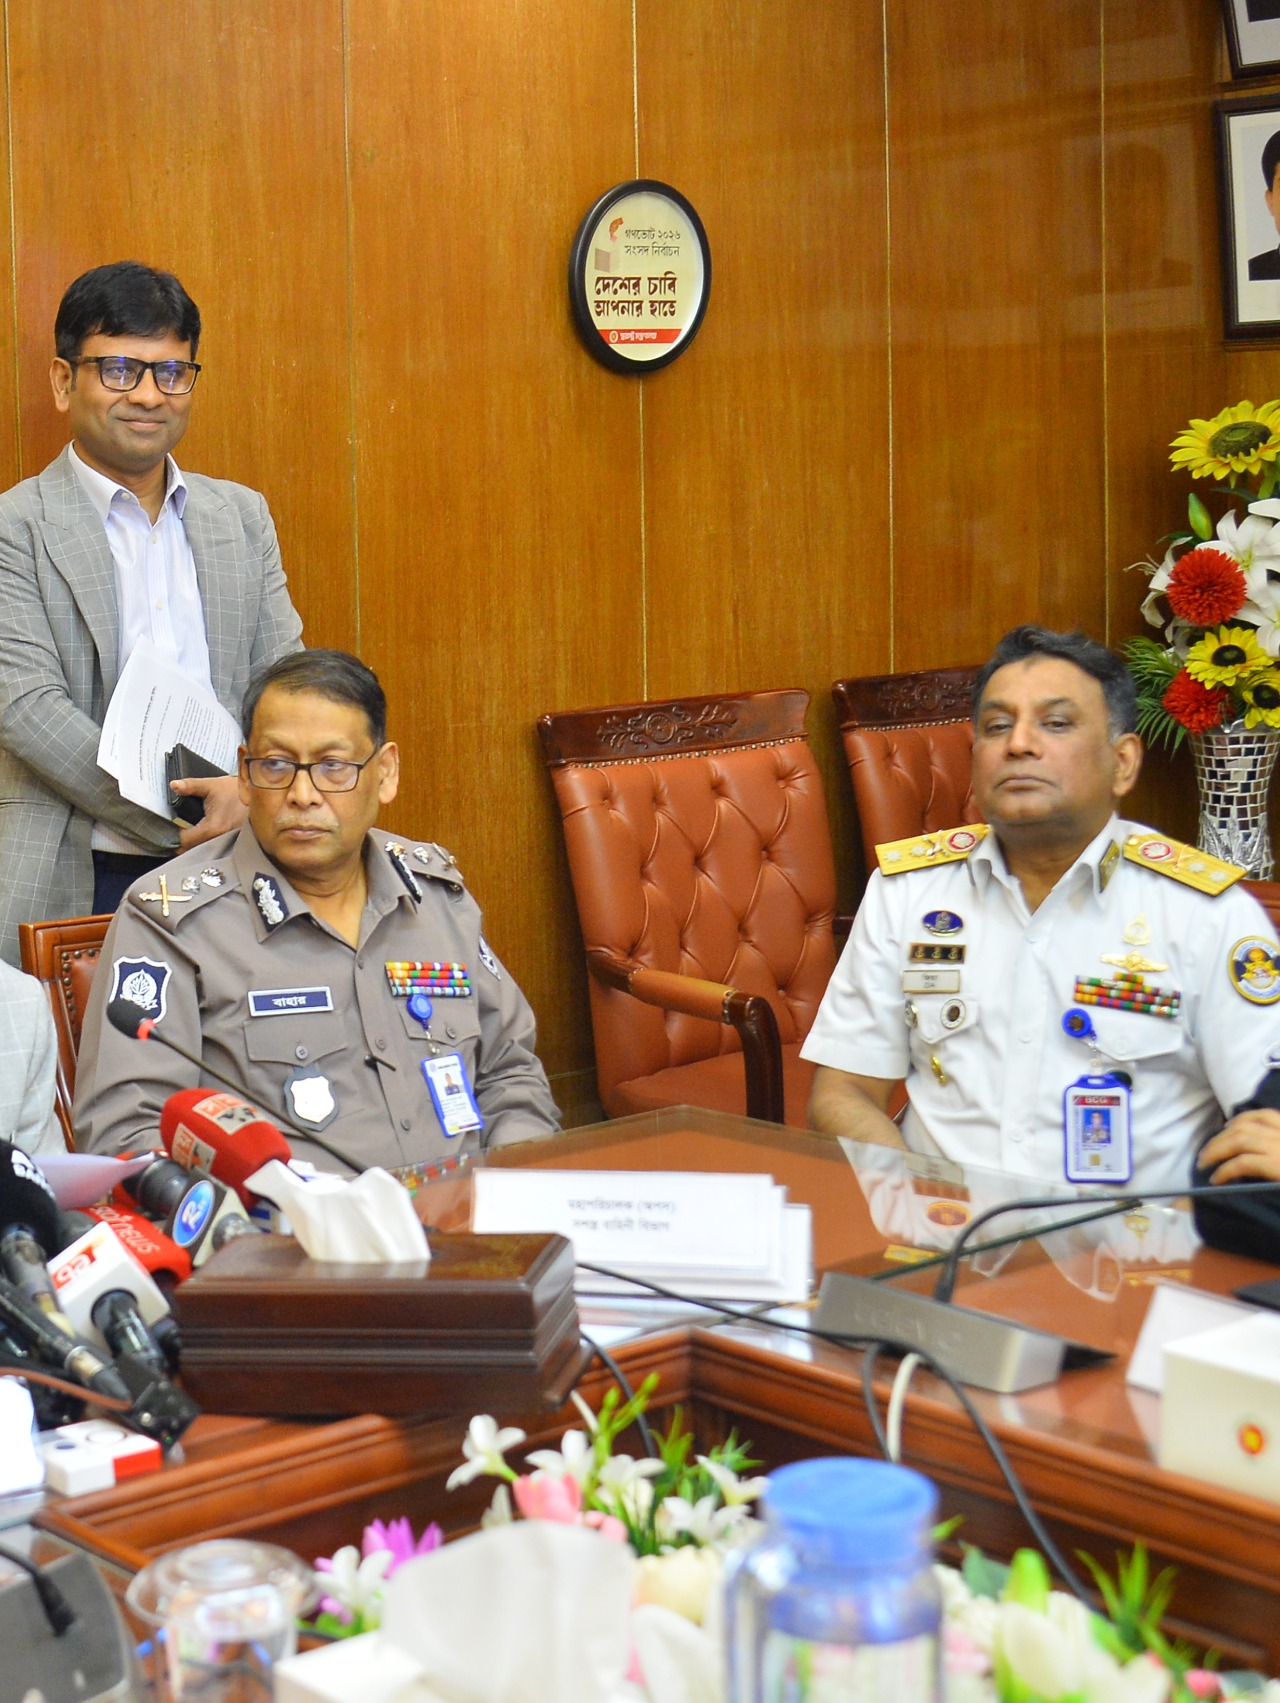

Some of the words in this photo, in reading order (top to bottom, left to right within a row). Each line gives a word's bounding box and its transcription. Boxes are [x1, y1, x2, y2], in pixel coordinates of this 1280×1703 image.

[594, 276, 642, 296] দেশের
[647, 271, 678, 296] চাবি
[594, 300, 643, 318] আপনার
[271, 995, 307, 1008] বাহার
